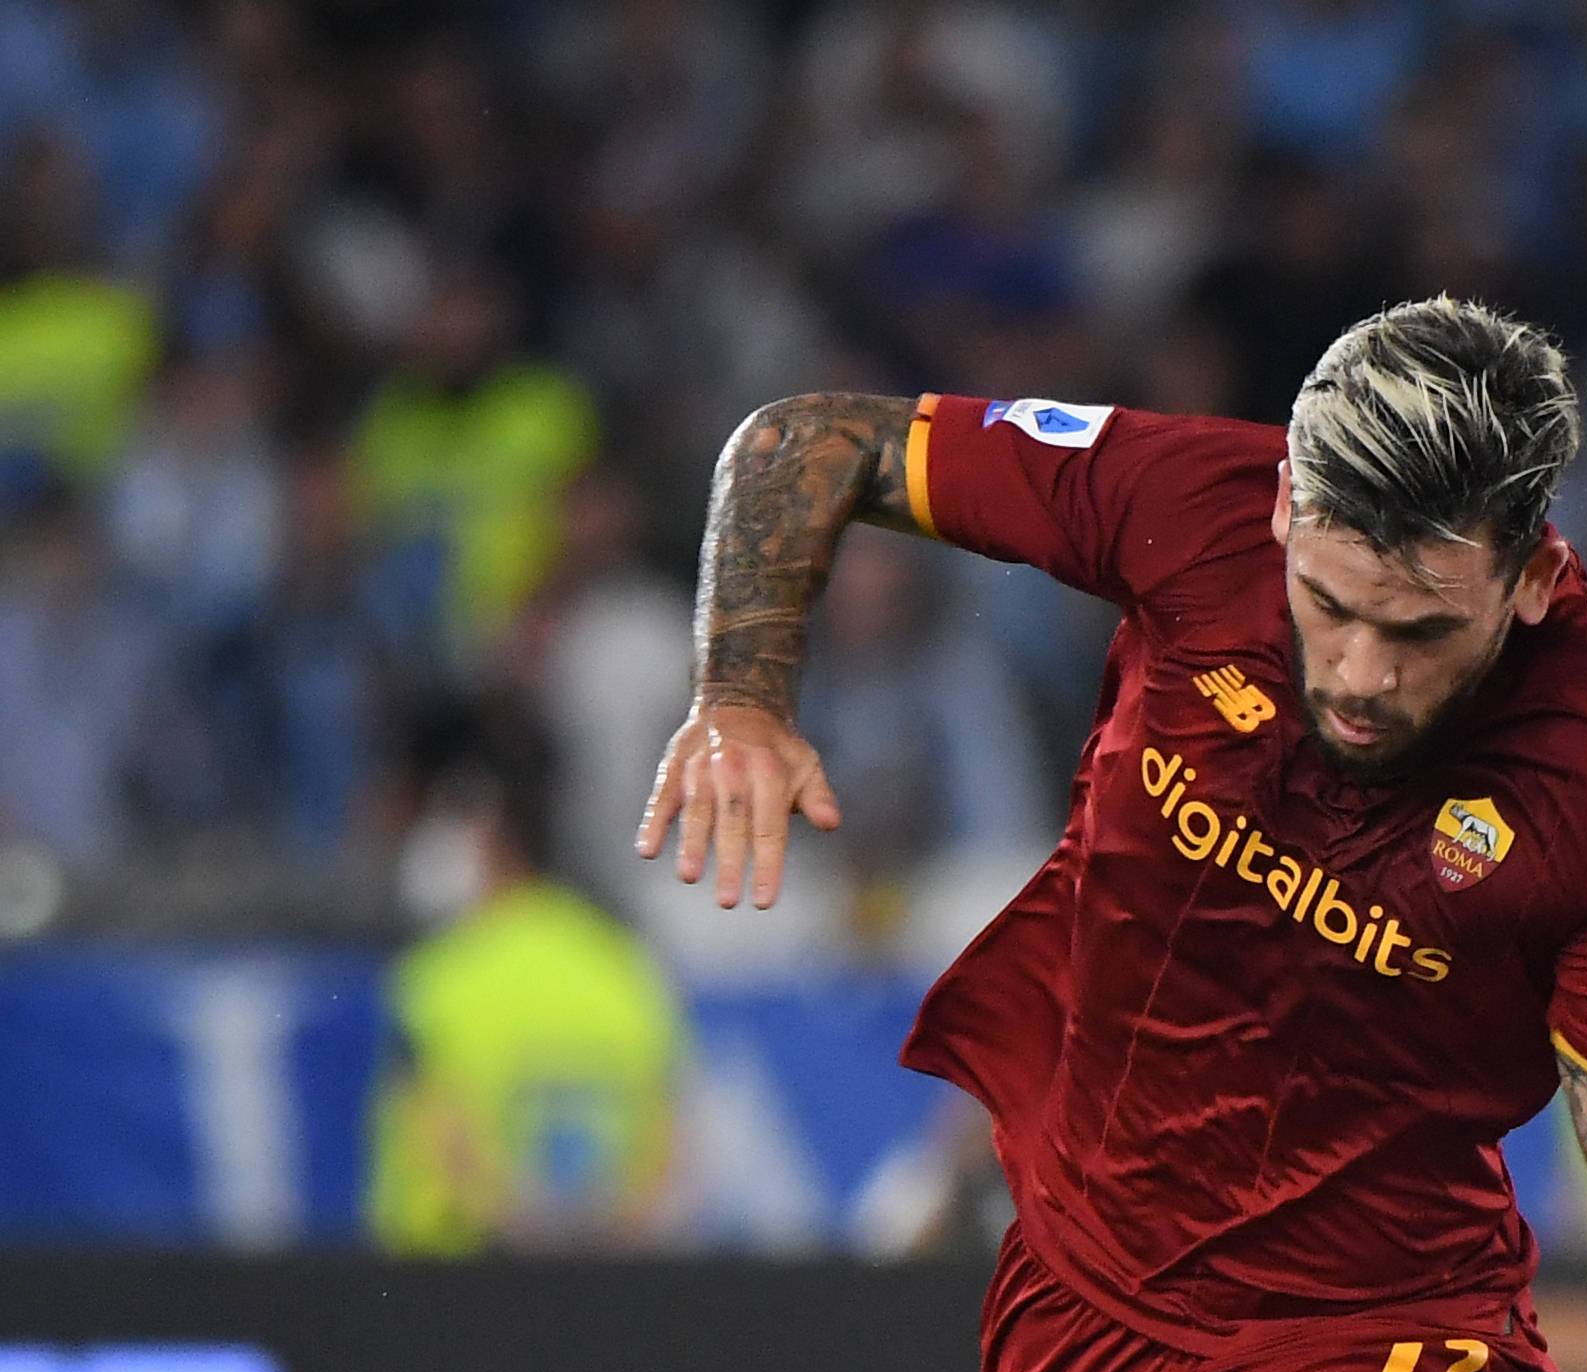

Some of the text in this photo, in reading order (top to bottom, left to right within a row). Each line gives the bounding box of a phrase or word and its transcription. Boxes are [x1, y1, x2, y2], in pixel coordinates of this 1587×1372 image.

[1141, 747, 1453, 982] digitalbits
[1433, 839, 1484, 878] ROMA
[1440, 866, 1464, 883] 1927
